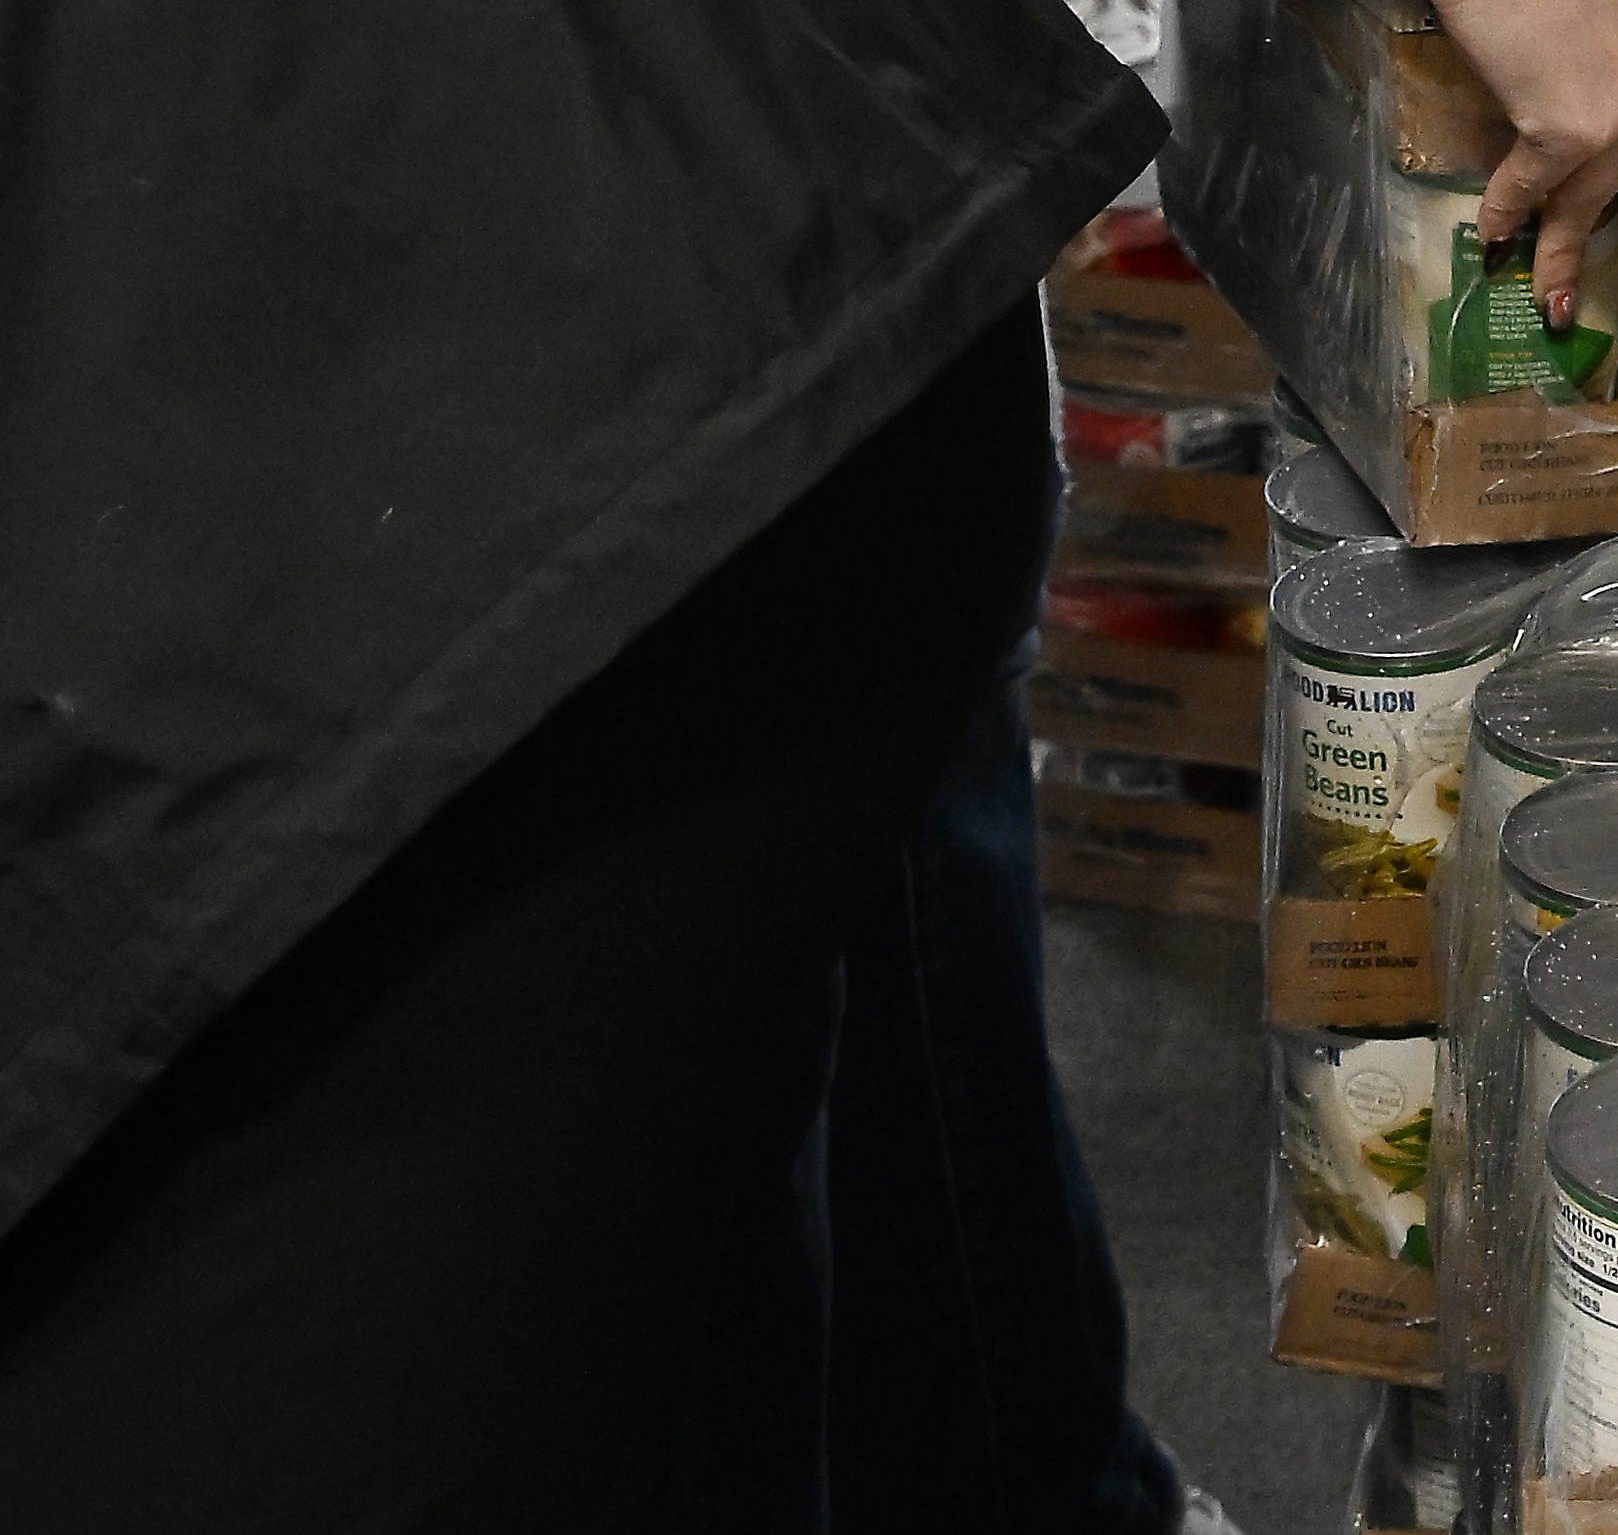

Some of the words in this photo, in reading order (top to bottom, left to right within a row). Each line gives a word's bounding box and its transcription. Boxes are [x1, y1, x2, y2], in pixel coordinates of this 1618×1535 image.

[1360, 690, 1416, 713] LION
[1326, 718, 1353, 738] Cut
[1302, 729, 1388, 772] Green
[1304, 762, 1389, 806] Beans
[1556, 1199, 1616, 1249] utrition
[1603, 1264, 1618, 1278] 1/2
